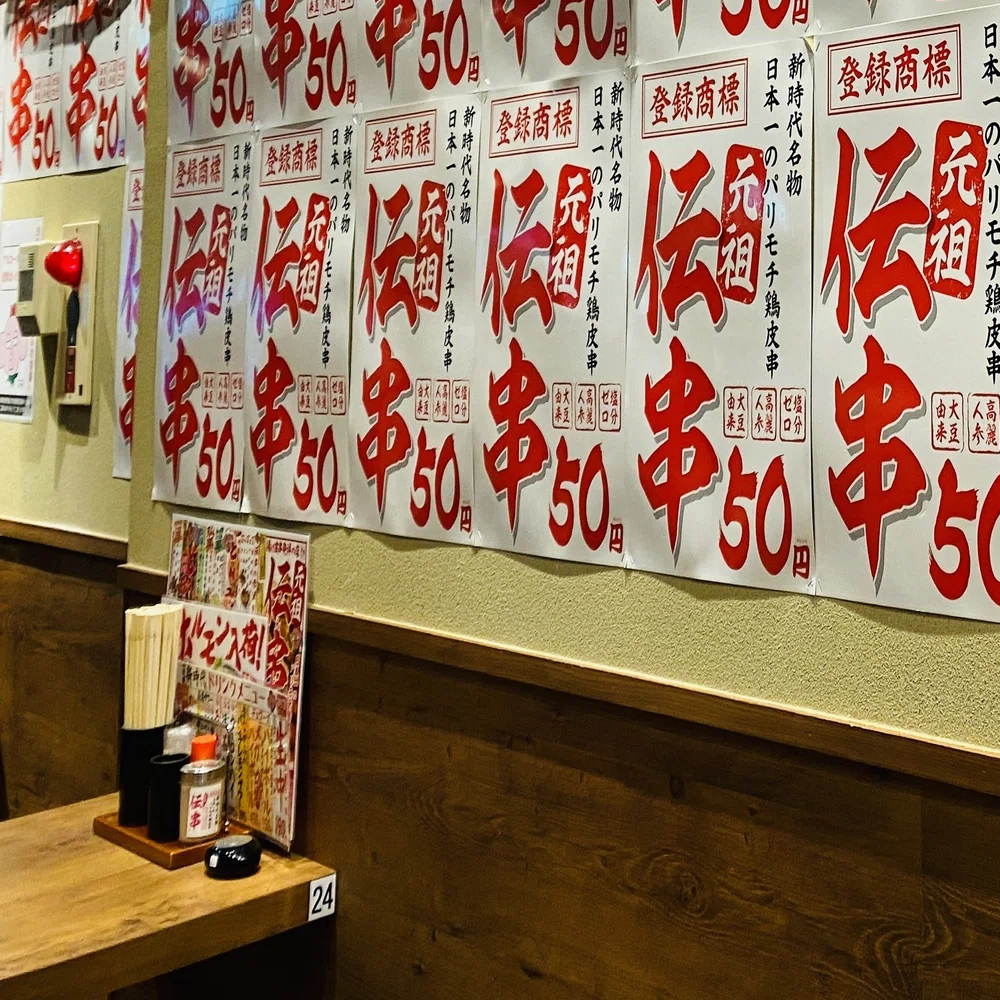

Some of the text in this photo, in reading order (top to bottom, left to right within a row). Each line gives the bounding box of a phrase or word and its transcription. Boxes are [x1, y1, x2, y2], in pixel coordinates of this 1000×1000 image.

[495, 98, 572, 147] 登録商標
[650, 71, 740, 126] 登録商標
[786, 51, 803, 197] 新時代名物
[837, 39, 951, 101] 登録商標
[370, 120, 431, 163] 登録商標
[459, 105, 473, 225] 新時代名物
[608, 80, 624, 213] 新時代名物
[415, 189, 442, 300] 元祖
[551, 174, 584, 296] 元祖
[586, 85, 604, 376] 日本一のパリモチ鶏皮串
[720, 155, 759, 290] 元祖
[763, 57, 780, 379] 日本一のパリモチ鶏皮串
[929, 132, 977, 284] 元祖
[311, 882, 334, 915] 24
